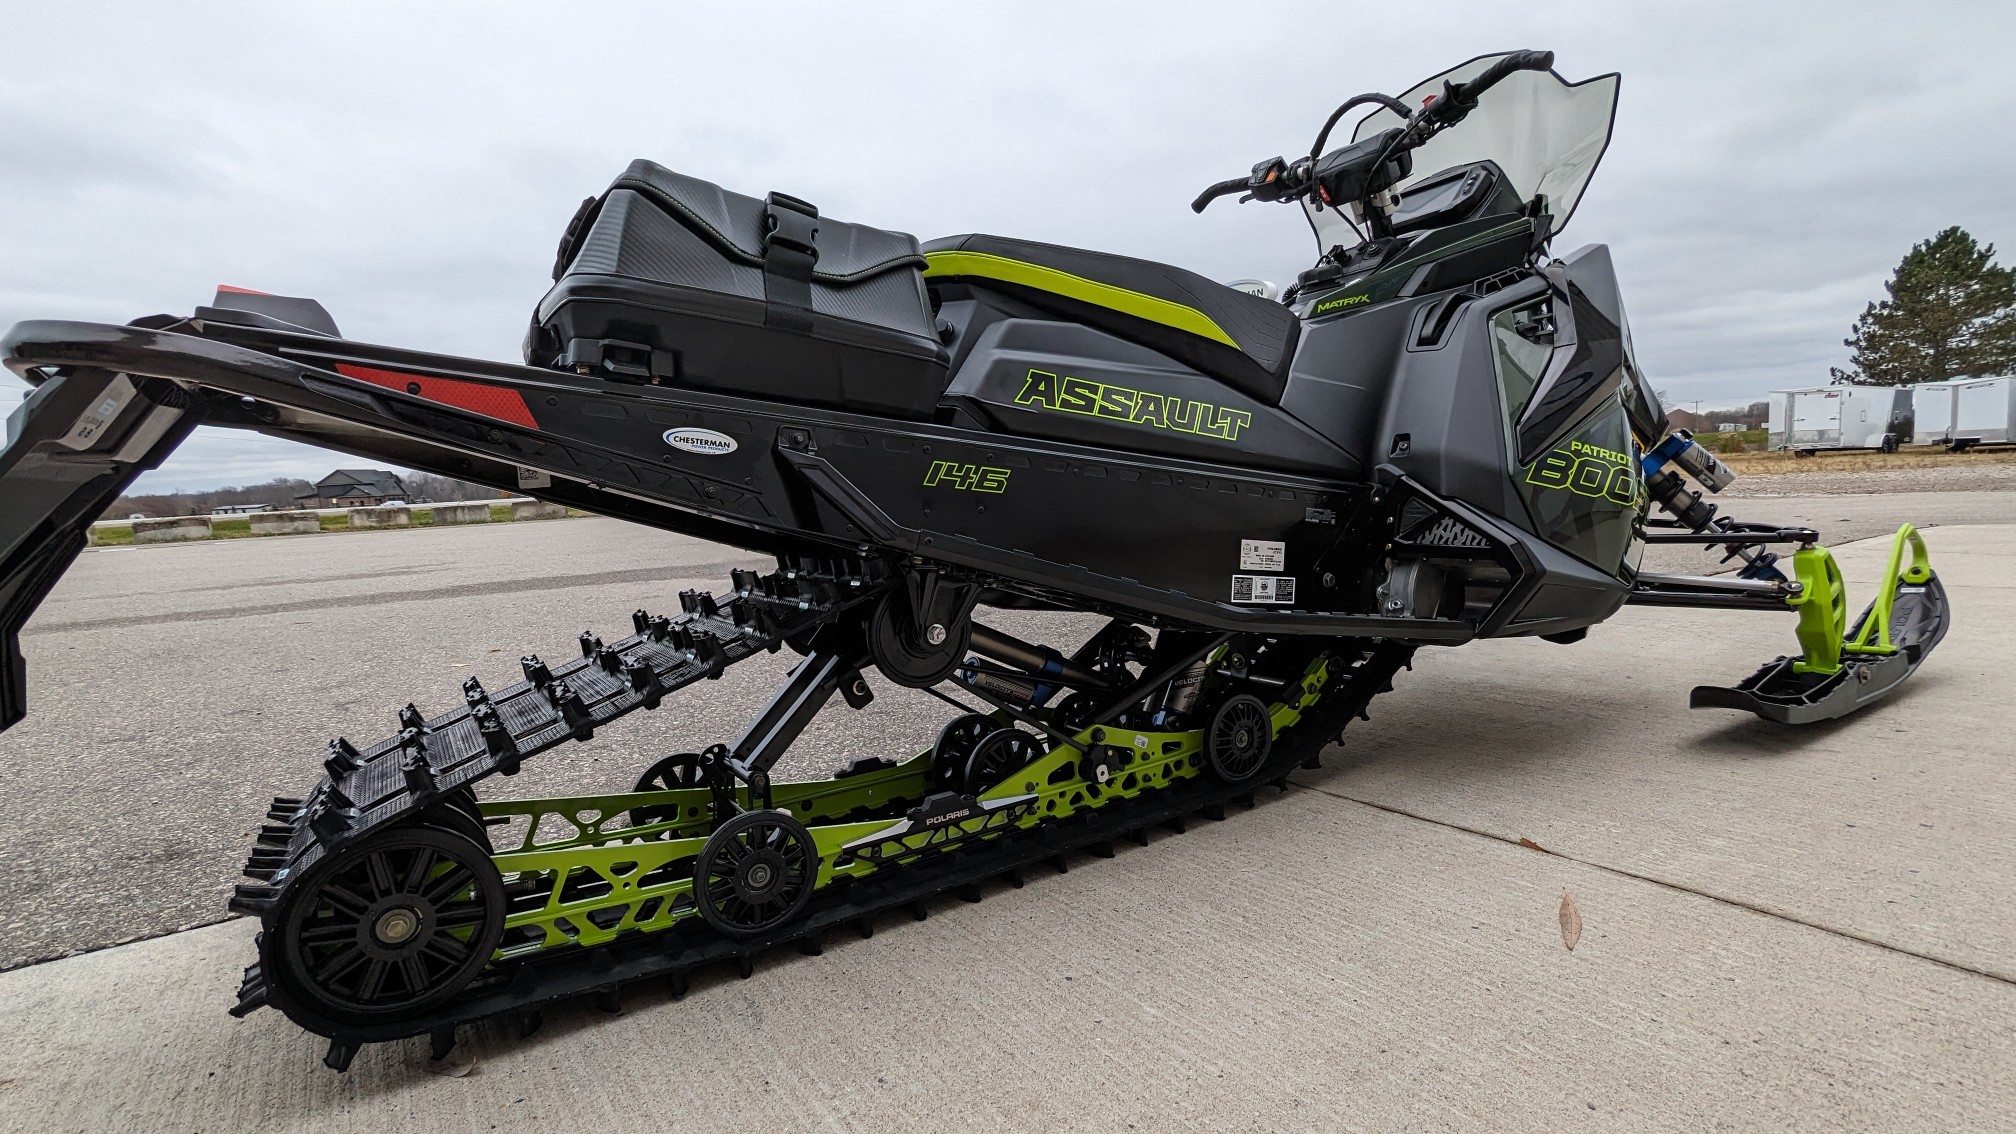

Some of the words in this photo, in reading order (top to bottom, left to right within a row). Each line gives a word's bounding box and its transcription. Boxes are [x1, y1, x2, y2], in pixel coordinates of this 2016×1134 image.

[1317, 294, 1370, 314] MATRYX
[1014, 369, 1251, 441] ASSAULT
[673, 436, 730, 448] CHESTERMAN
[1571, 441, 1633, 467] PATRIOT
[923, 461, 1011, 493] 146
[926, 808, 970, 826] POLARIS
